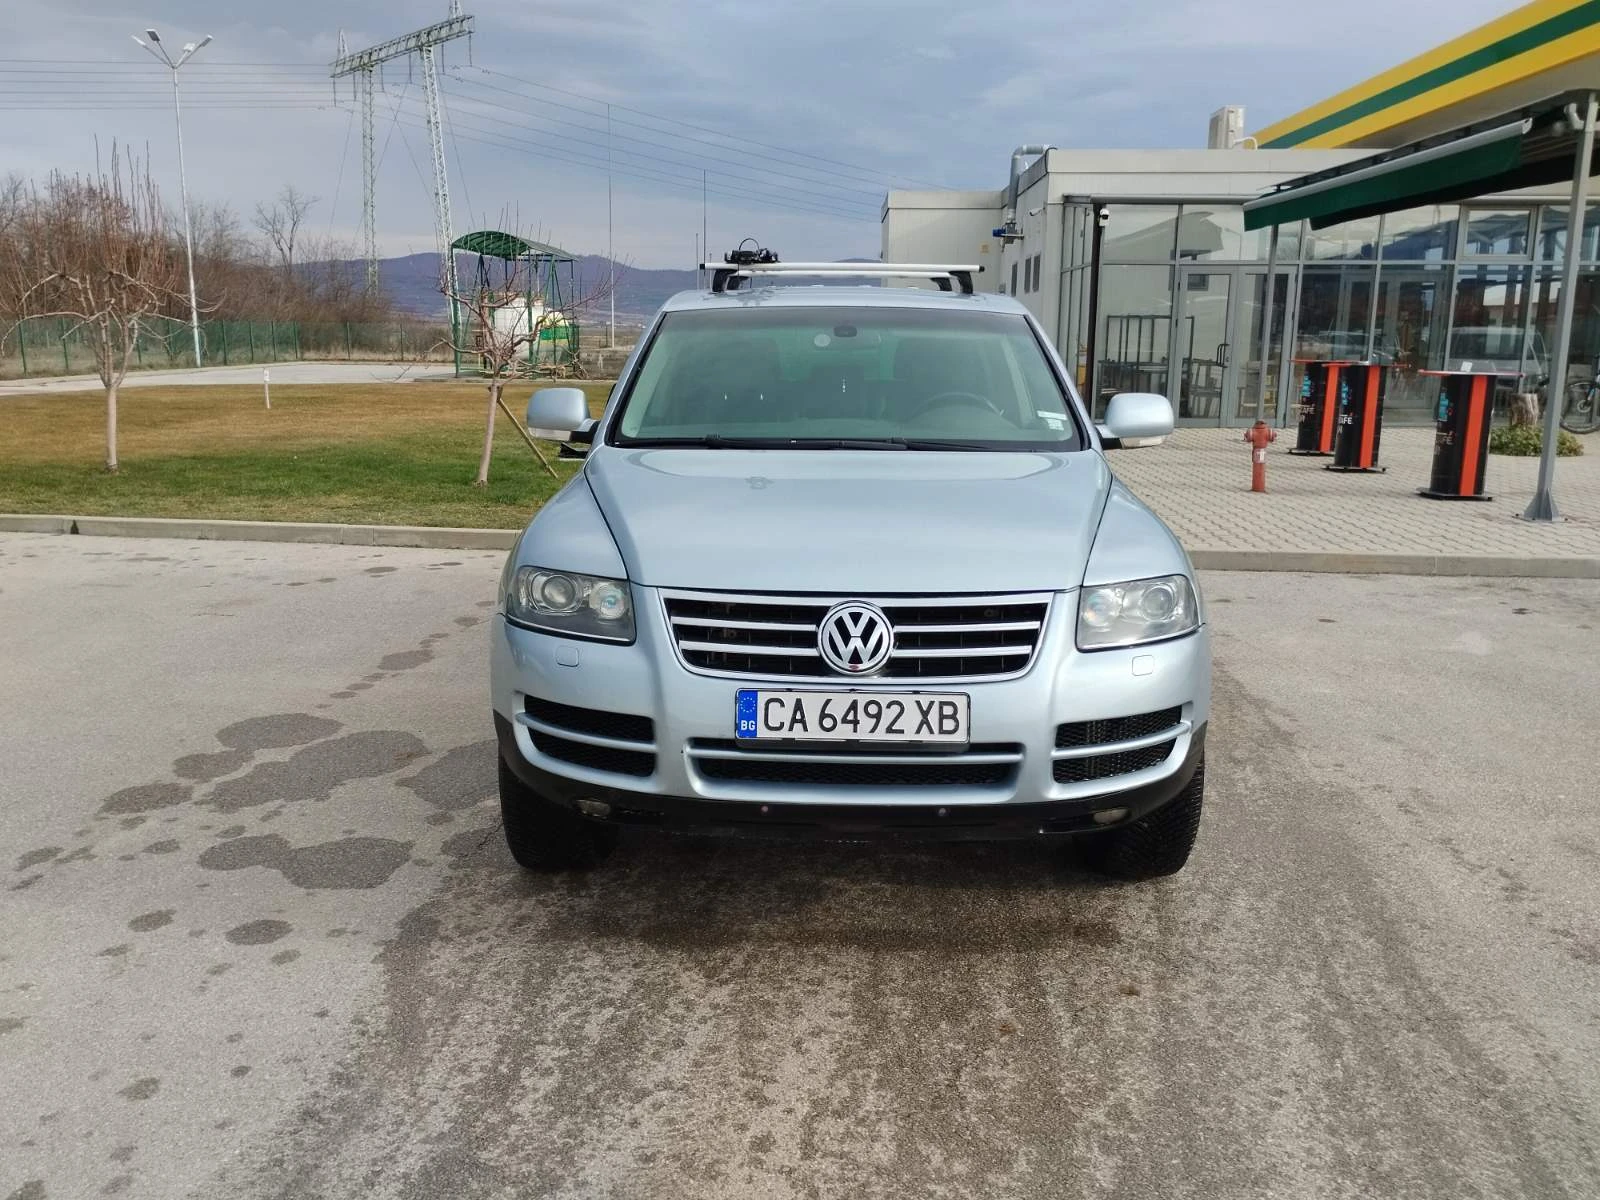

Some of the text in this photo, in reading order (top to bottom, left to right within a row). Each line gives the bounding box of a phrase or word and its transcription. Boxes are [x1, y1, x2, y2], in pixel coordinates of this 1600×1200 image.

[820, 604, 891, 673] VW
[740, 719, 756, 732] BG
[763, 697, 960, 735] CA 6492 XB
